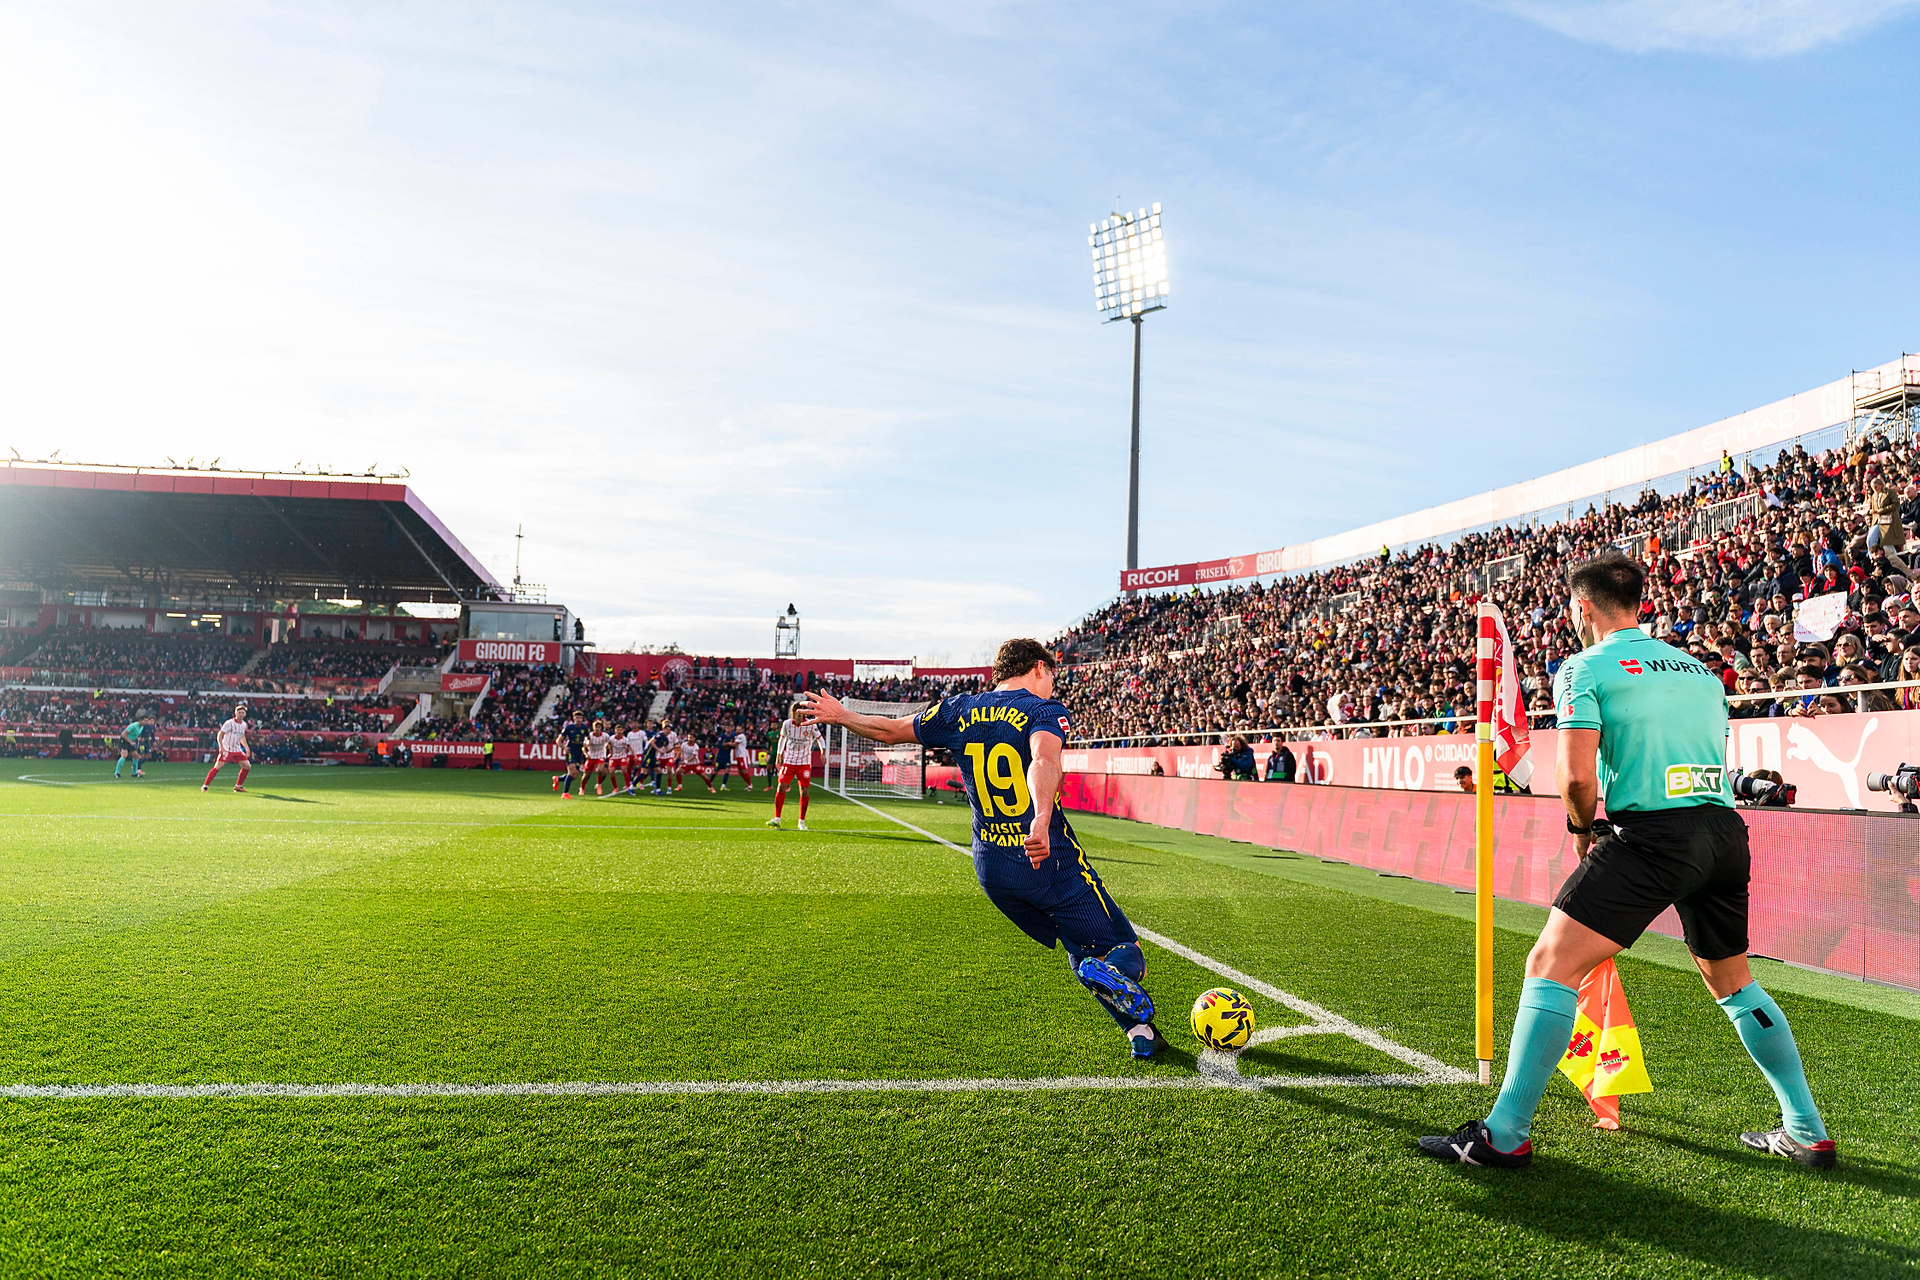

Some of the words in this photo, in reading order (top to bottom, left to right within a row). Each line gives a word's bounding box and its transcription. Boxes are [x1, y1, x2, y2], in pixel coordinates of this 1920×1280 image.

[1701, 408, 1800, 453] ETIHAD
[1127, 569, 1179, 586] RICOH
[1195, 563, 1236, 580] FRISELVA
[475, 642, 526, 660] GIRONA
[528, 644, 546, 661] FC
[958, 714, 970, 733] J.
[970, 706, 1029, 732] ALVAREZ
[411, 743, 456, 754] ESTRELLA
[456, 745, 485, 755] DAMM
[519, 743, 567, 760] LALI
[1363, 745, 1425, 790] HYLO
[964, 742, 1031, 818] 19
[1668, 767, 1721, 795] BKT
[980, 828, 1028, 847] RWAND
